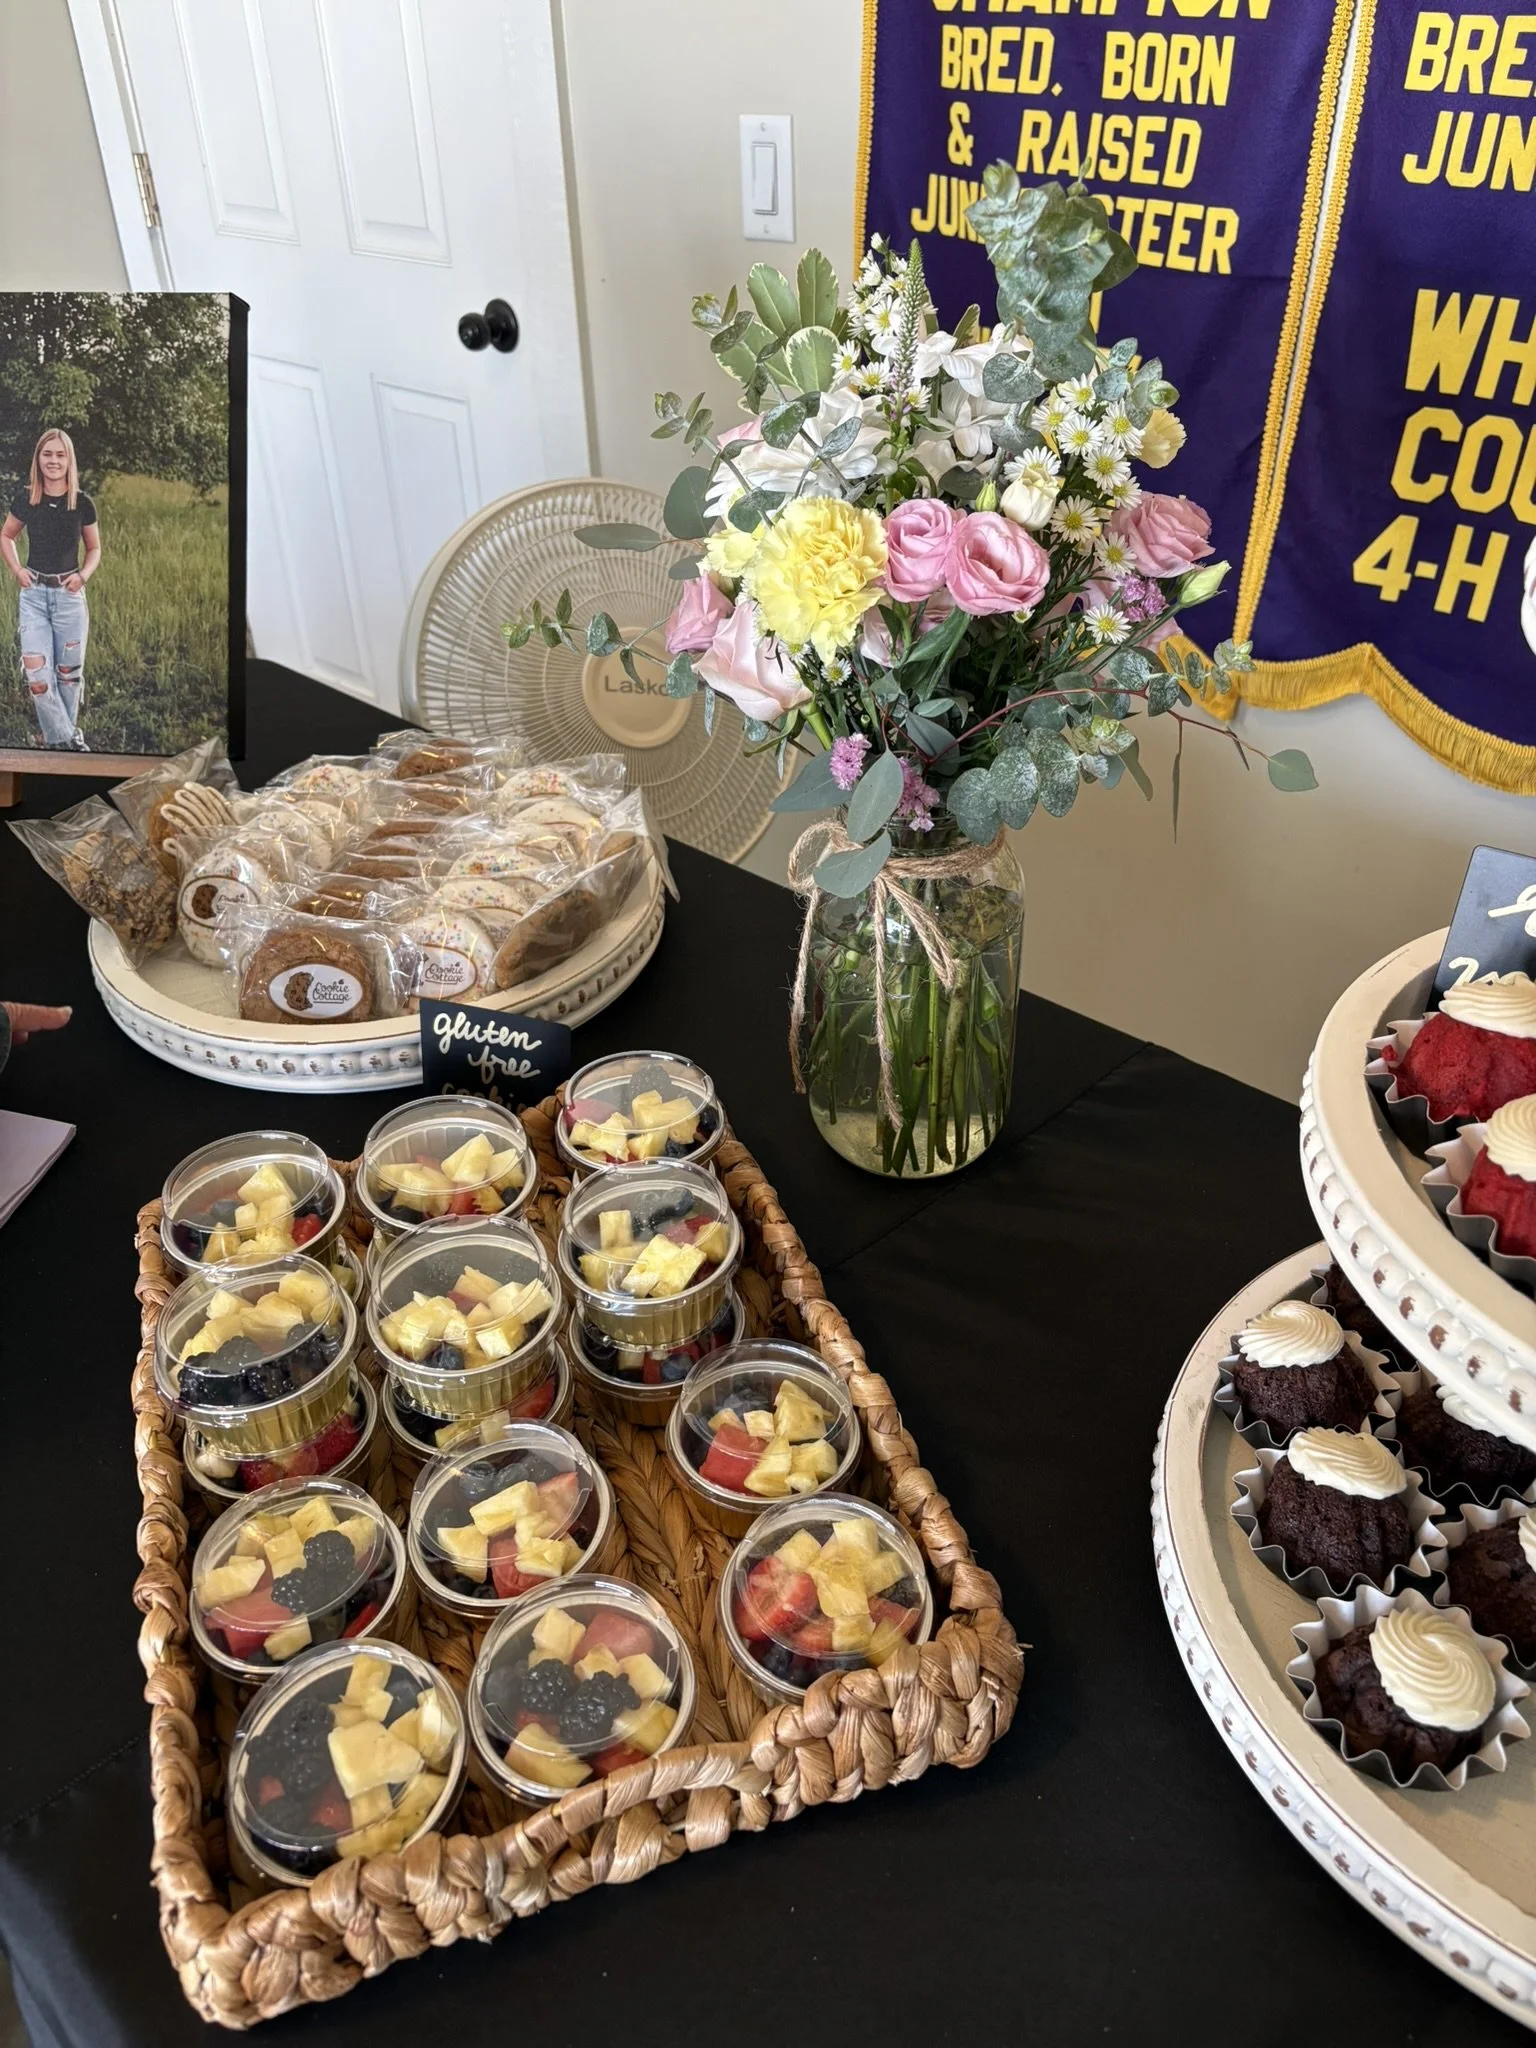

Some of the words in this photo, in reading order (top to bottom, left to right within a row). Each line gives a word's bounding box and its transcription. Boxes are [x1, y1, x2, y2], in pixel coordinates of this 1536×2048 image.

[1102, 31, 1235, 106] BORN
[1404, 11, 1536, 98] BRE
[947, 101, 974, 167] &
[1016, 109, 1201, 189] RAISED
[1402, 110, 1536, 192] JUN
[1405, 288, 1536, 406] WH
[1353, 514, 1510, 623] 4-H
[313, 988, 352, 1002] Cottage
[316, 981, 349, 994] Cookie
[434, 1012, 542, 1054] gluten
[467, 1045, 541, 1084] free
